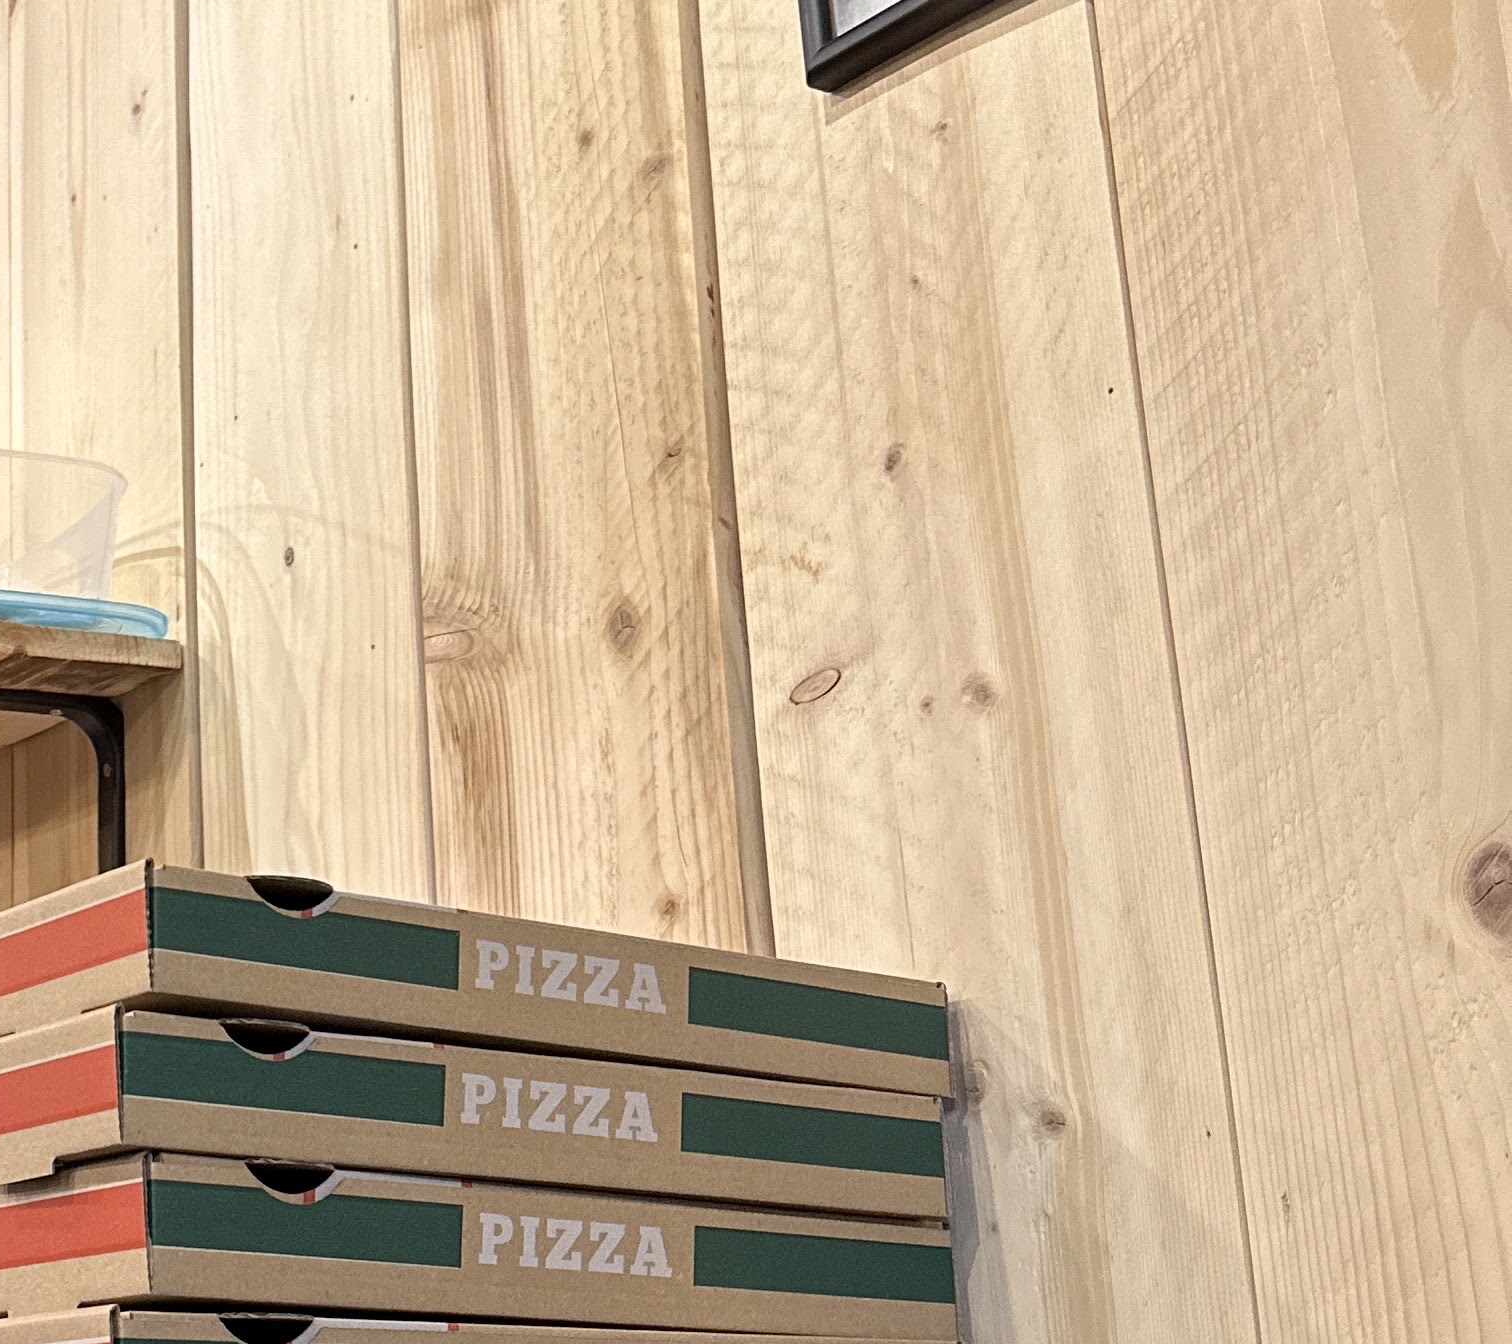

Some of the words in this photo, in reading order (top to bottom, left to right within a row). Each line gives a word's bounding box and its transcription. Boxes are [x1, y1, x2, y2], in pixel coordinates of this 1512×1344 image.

[474, 938, 667, 1016] PIZZA
[460, 1072, 659, 1144] PIZZA
[478, 1212, 673, 1279] PIZZA
